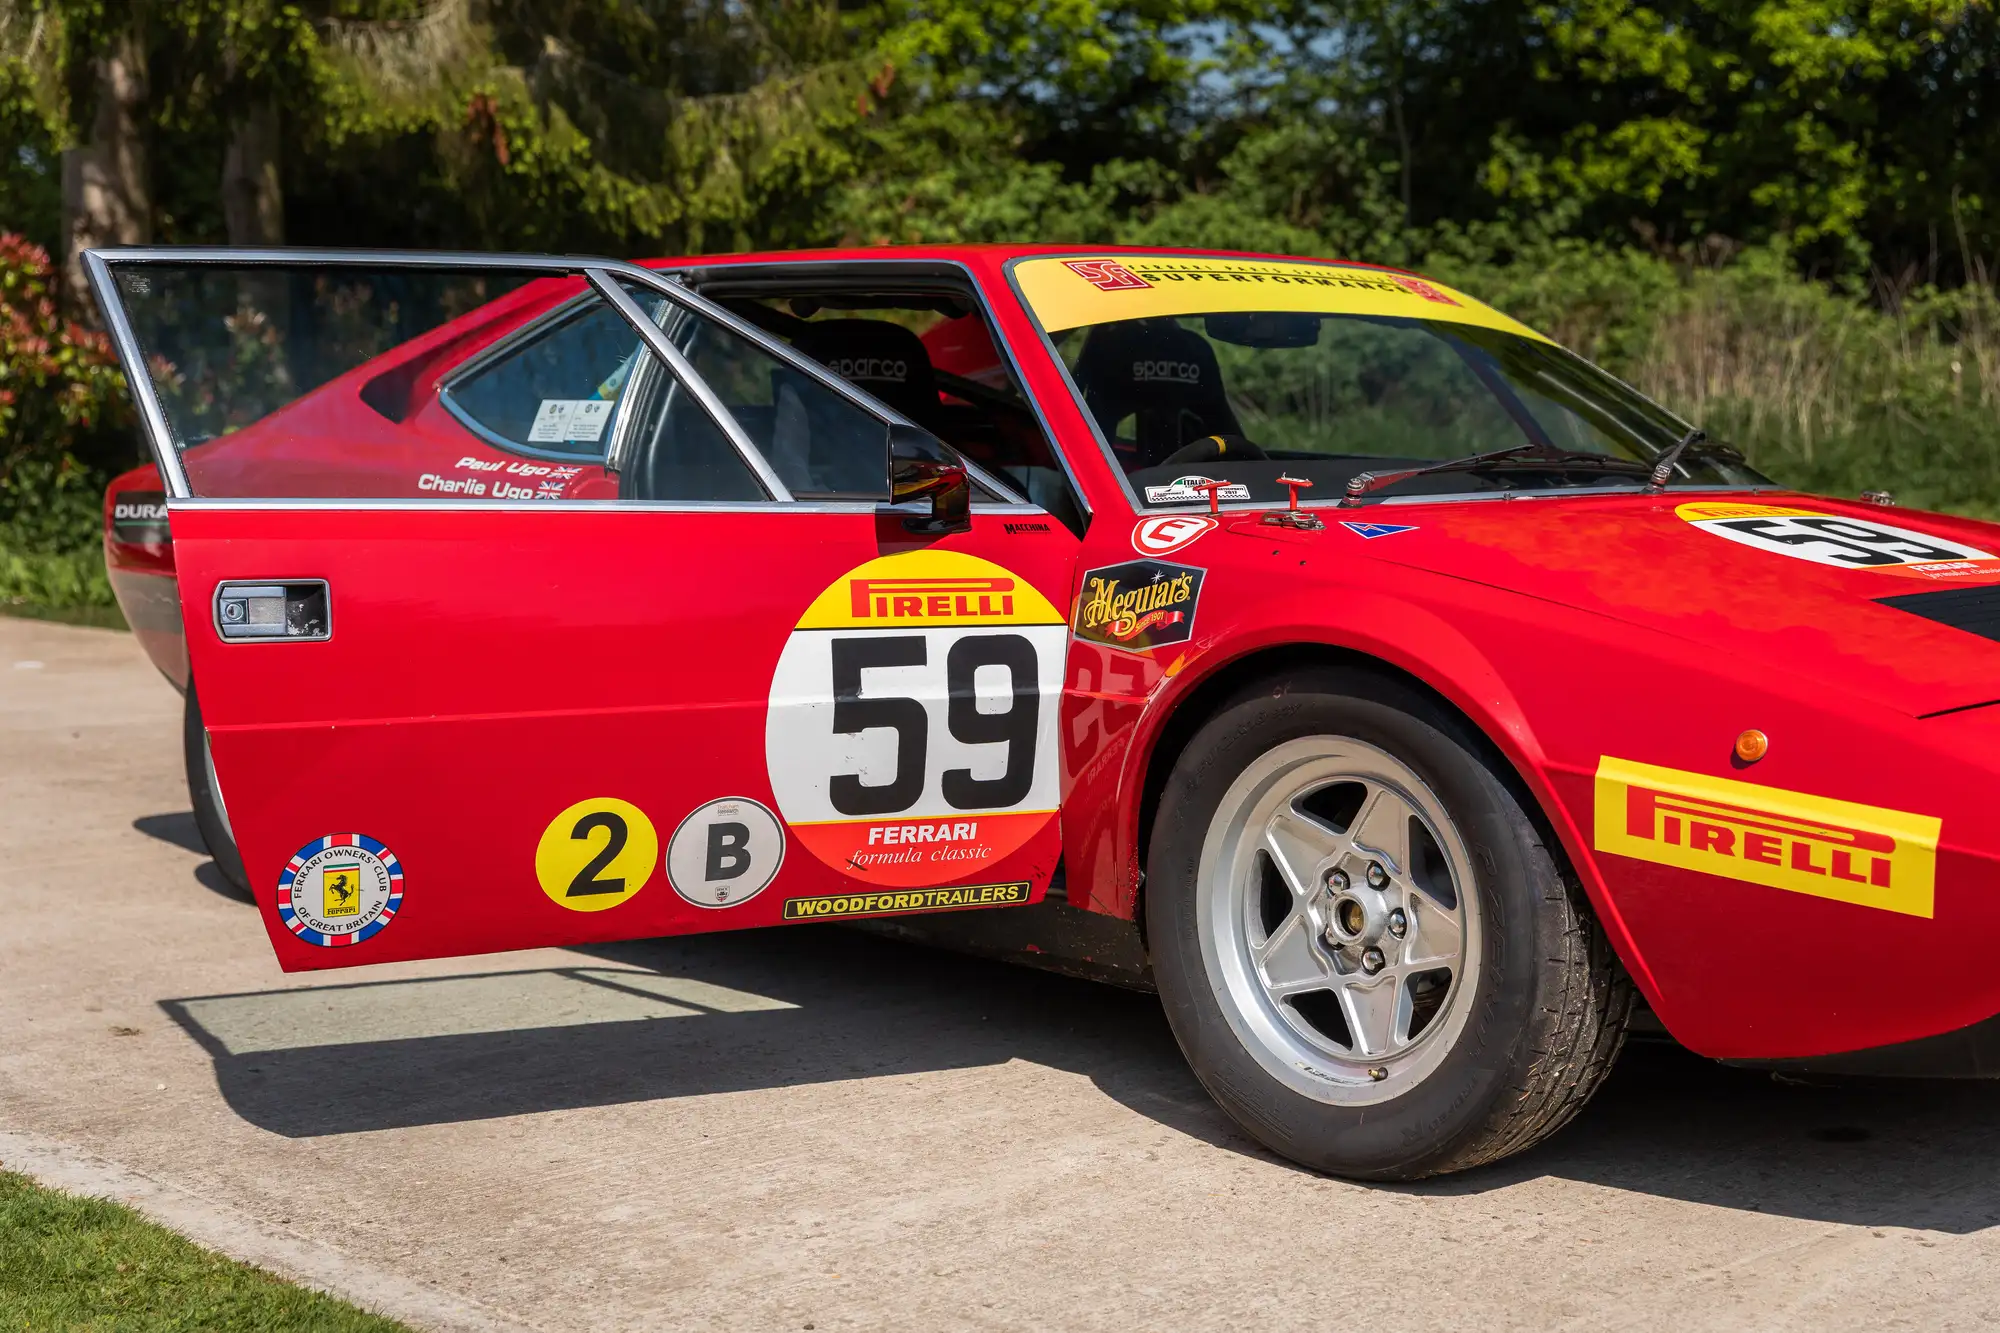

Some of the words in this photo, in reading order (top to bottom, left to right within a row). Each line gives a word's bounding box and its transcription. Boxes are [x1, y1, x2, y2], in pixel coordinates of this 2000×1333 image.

[1141, 273, 1413, 295] SUPERFORMANCE
[1132, 360, 1200, 381] sparco
[454, 456, 505, 471] Paul
[506, 462, 551, 476] Ugo
[418, 473, 486, 495] Charlie
[492, 480, 534, 499] Ugo
[1003, 523, 1051, 535] MACCHINA
[1712, 518, 1968, 565] 59
[850, 577, 1015, 618] PIRELLI
[1084, 571, 1193, 637] Meguiar's
[1151, 611, 1164, 622] 1901
[829, 634, 1040, 816] 59
[868, 822, 978, 845] FERRARI
[1627, 784, 1896, 889] PIRELLI
[565, 811, 628, 897] 2
[705, 822, 751, 882] B
[846, 849, 921, 870] formula
[931, 845, 992, 862] classic
[294, 857, 322, 899] FERRARI
[324, 849, 375, 864] OWNERS'
[373, 865, 387, 892] CLUB
[298, 907, 311, 919] OF
[309, 918, 343, 932] GREAT
[346, 900, 382, 930] BRITAIN
[327, 906, 356, 915] Ferrari
